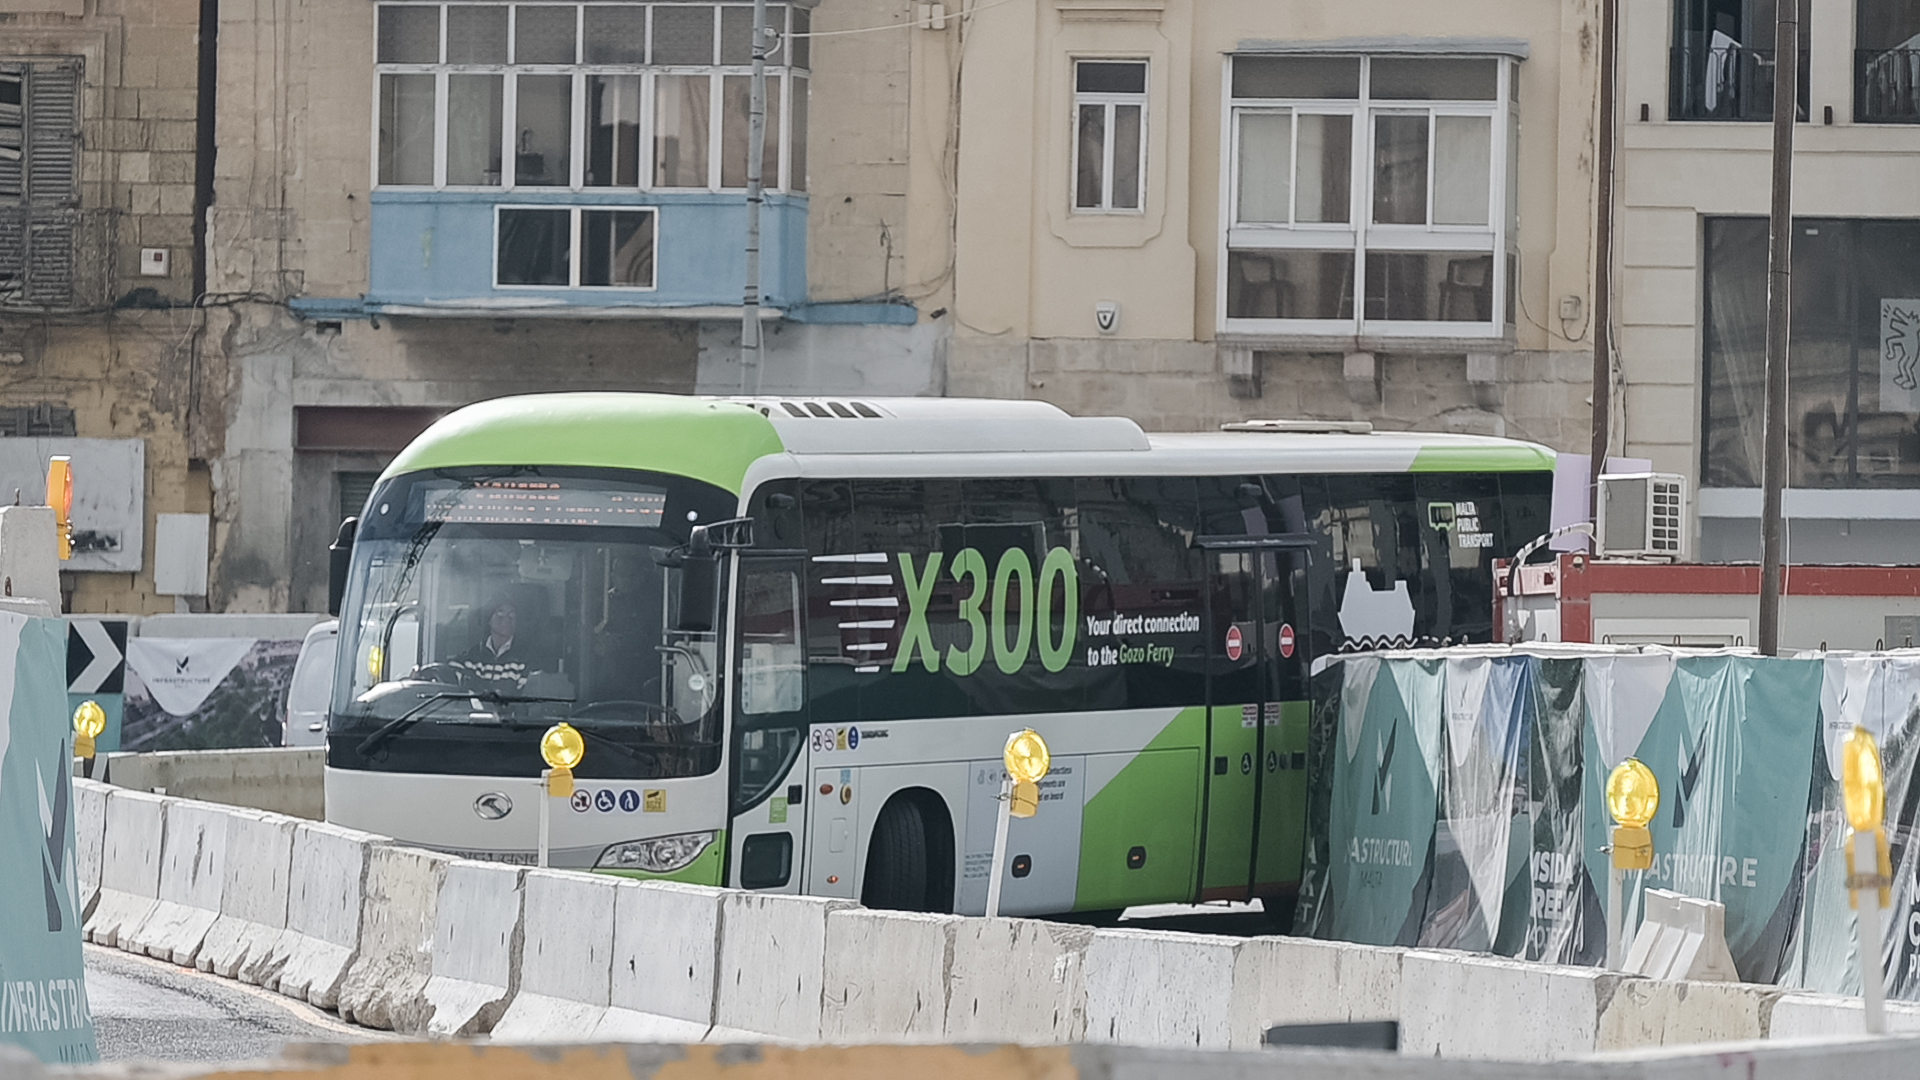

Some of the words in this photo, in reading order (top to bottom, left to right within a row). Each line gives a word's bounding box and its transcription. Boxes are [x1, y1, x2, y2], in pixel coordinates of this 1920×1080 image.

[1457, 517, 1479, 532] PUBLIC
[1458, 533, 1494, 548] TRANSPORT
[891, 546, 1079, 677] X300
[1086, 615, 1112, 636] Your
[1112, 611, 1143, 635] direct
[1144, 611, 1200, 633] connection
[1087, 647, 1099, 666] to
[1100, 645, 1118, 665] the
[1119, 643, 1145, 664] Gozo
[1146, 643, 1175, 667] Ferry
